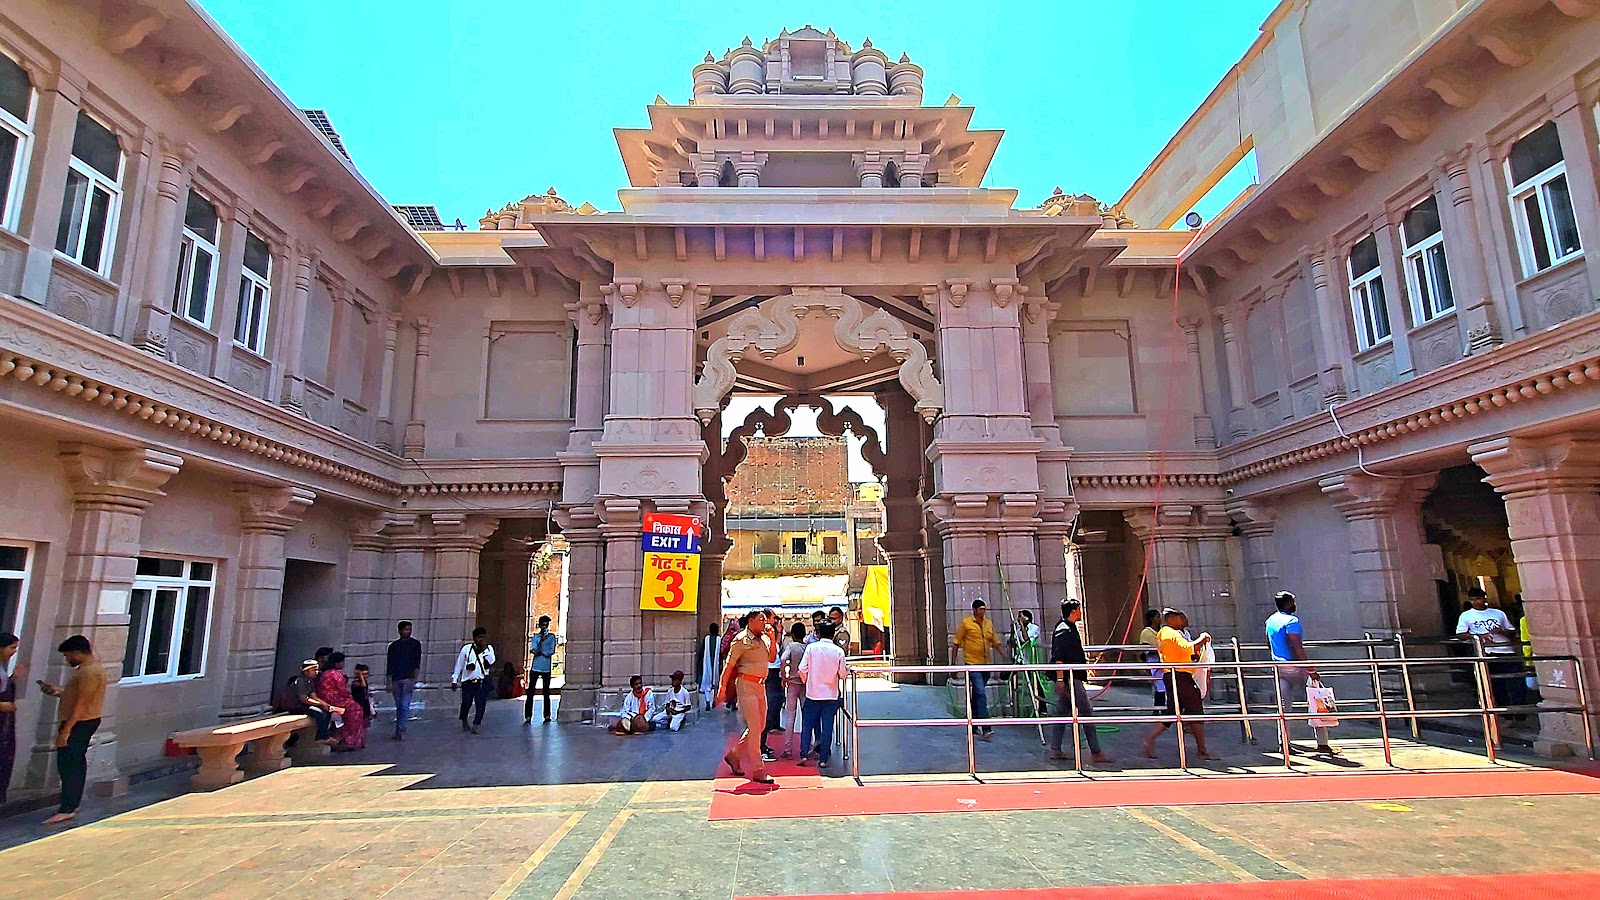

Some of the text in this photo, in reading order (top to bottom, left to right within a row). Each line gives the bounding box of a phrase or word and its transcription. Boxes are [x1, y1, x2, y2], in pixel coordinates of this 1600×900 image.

[653, 522, 681, 535] निकास
[651, 536, 680, 548] EXIT
[651, 554, 673, 570] गेट
[654, 570, 684, 609] 3
